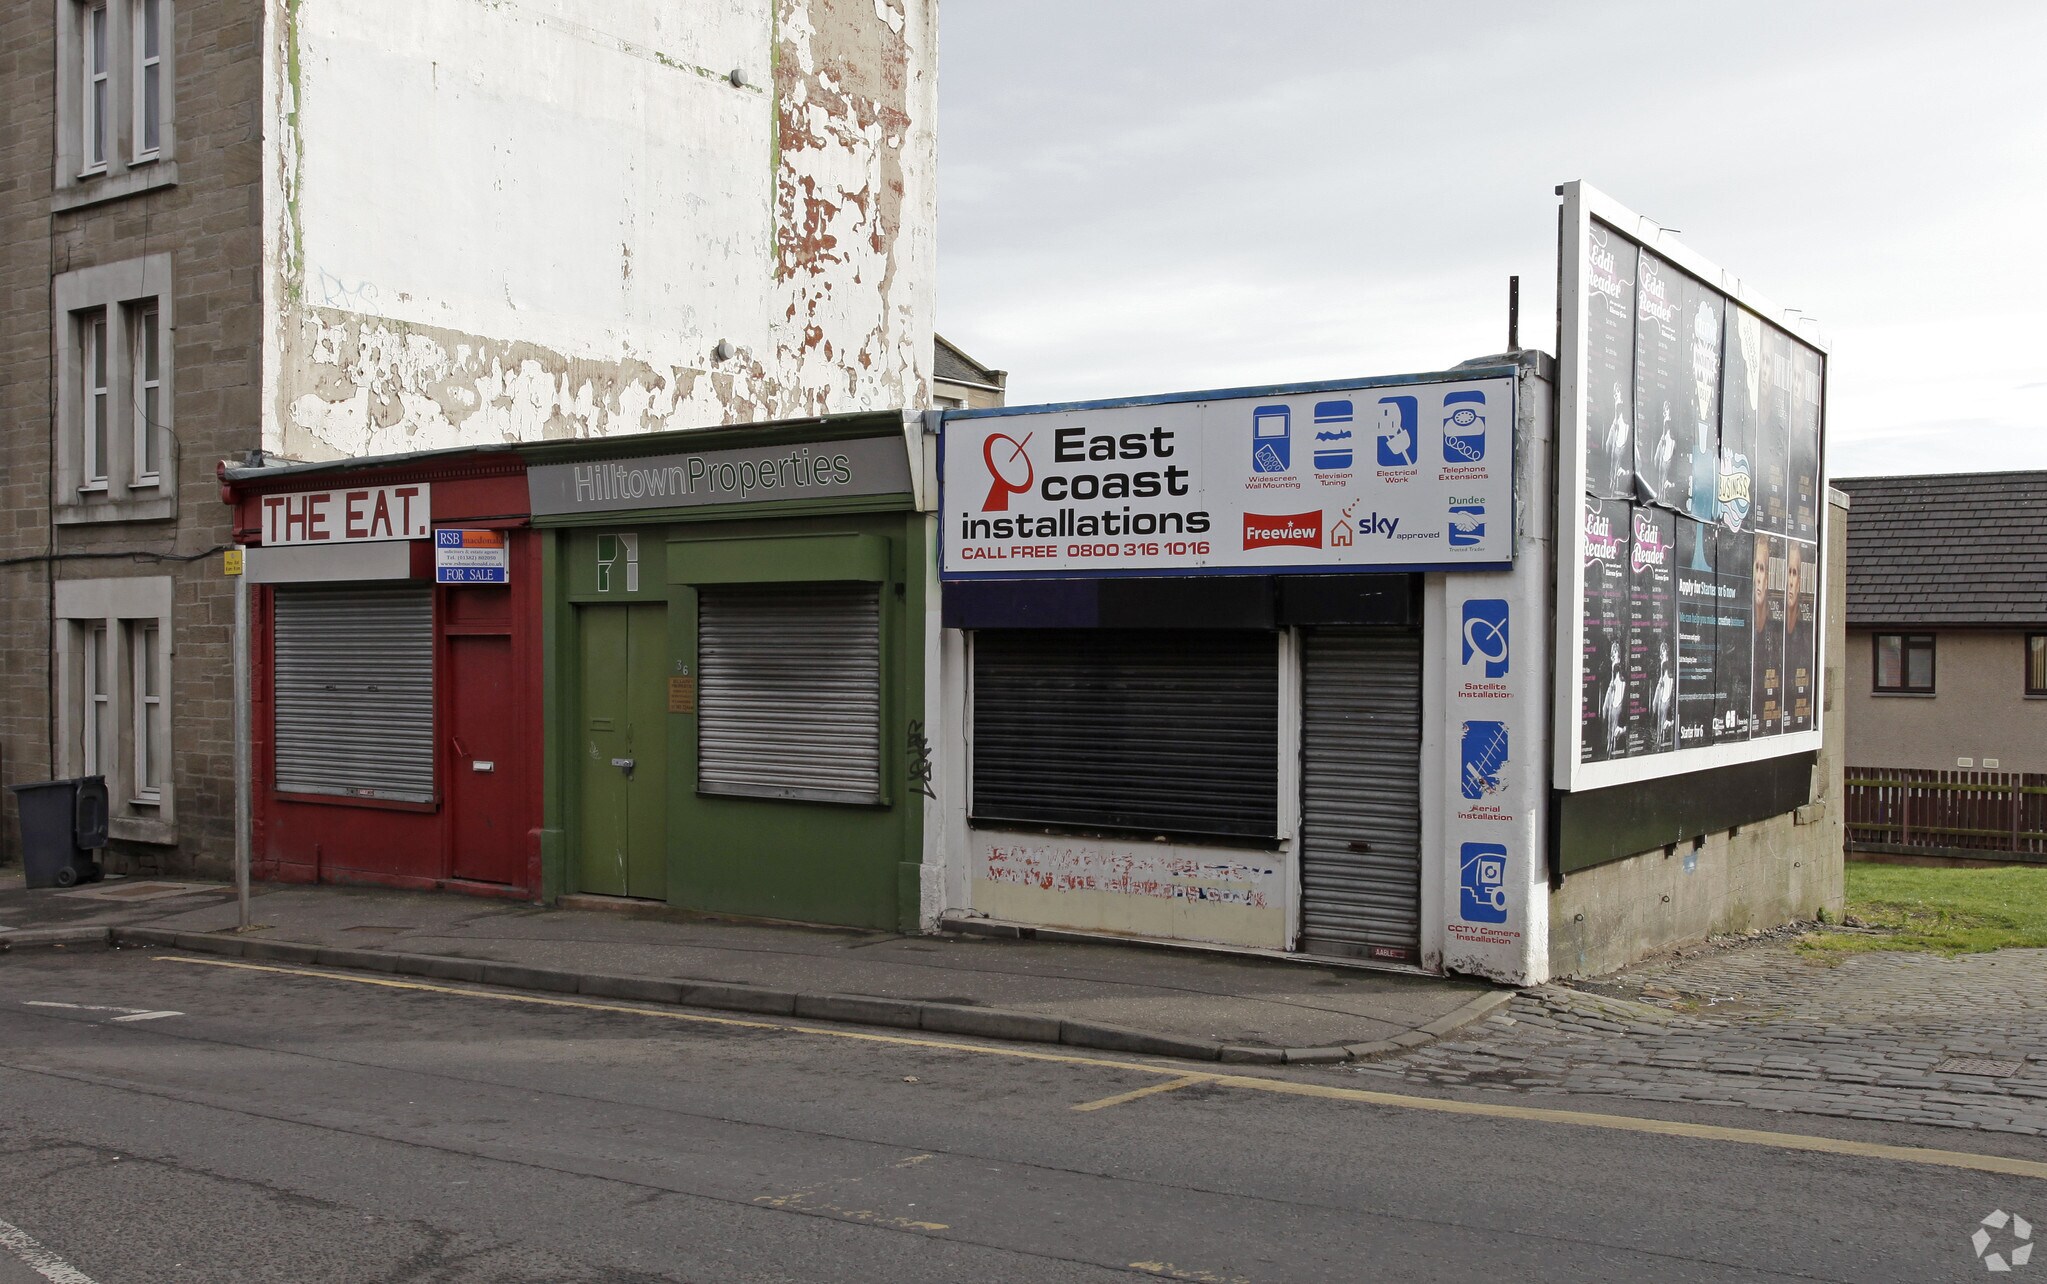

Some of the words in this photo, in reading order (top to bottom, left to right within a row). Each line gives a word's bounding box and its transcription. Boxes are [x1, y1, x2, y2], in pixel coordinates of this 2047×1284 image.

[1592, 245, 1615, 274] Eddi
[1588, 264, 1621, 298] Reader
[1645, 273, 1665, 300] Eddi
[1639, 290, 1671, 323] Reader
[1054, 426, 1175, 463] East
[1314, 472, 1353, 480] Television
[1376, 469, 1418, 477] Electrical
[1438, 473, 1489, 481] Extensions
[1442, 466, 1486, 475] Telephone
[1041, 465, 1189, 501] coast
[1262, 481, 1301, 490] Mounting
[1320, 479, 1347, 487] Tuning
[1385, 476, 1409, 484] Work
[1448, 496, 1486, 505] Dundee
[264, 493, 331, 542] THE
[345, 487, 426, 538] EAT.
[962, 505, 1211, 540] installations
[1246, 525, 1317, 540] Freeview
[1358, 512, 1400, 539] sky
[1396, 531, 1440, 540] approved
[1587, 514, 1609, 537] Eddi
[1640, 522, 1659, 544] Eddi
[440, 532, 461, 545] RSB
[1583, 535, 1617, 560] Reader
[961, 547, 1007, 560] CALL
[1011, 545, 1058, 559] FREE
[1067, 543, 1120, 557] 0800
[1123, 543, 1159, 556] 316
[1164, 541, 1210, 556] 1016
[1634, 542, 1664, 565] Reader
[446, 569, 464, 581] FOR
[469, 569, 494, 581] SALE
[1679, 578, 1694, 597] Apply
[677, 659, 689, 676] 36
[1458, 812, 1513, 821] Installation
[1447, 924, 1478, 934] CCTV
[1480, 927, 1520, 938] Camera
[1456, 933, 1511, 945] Installation
